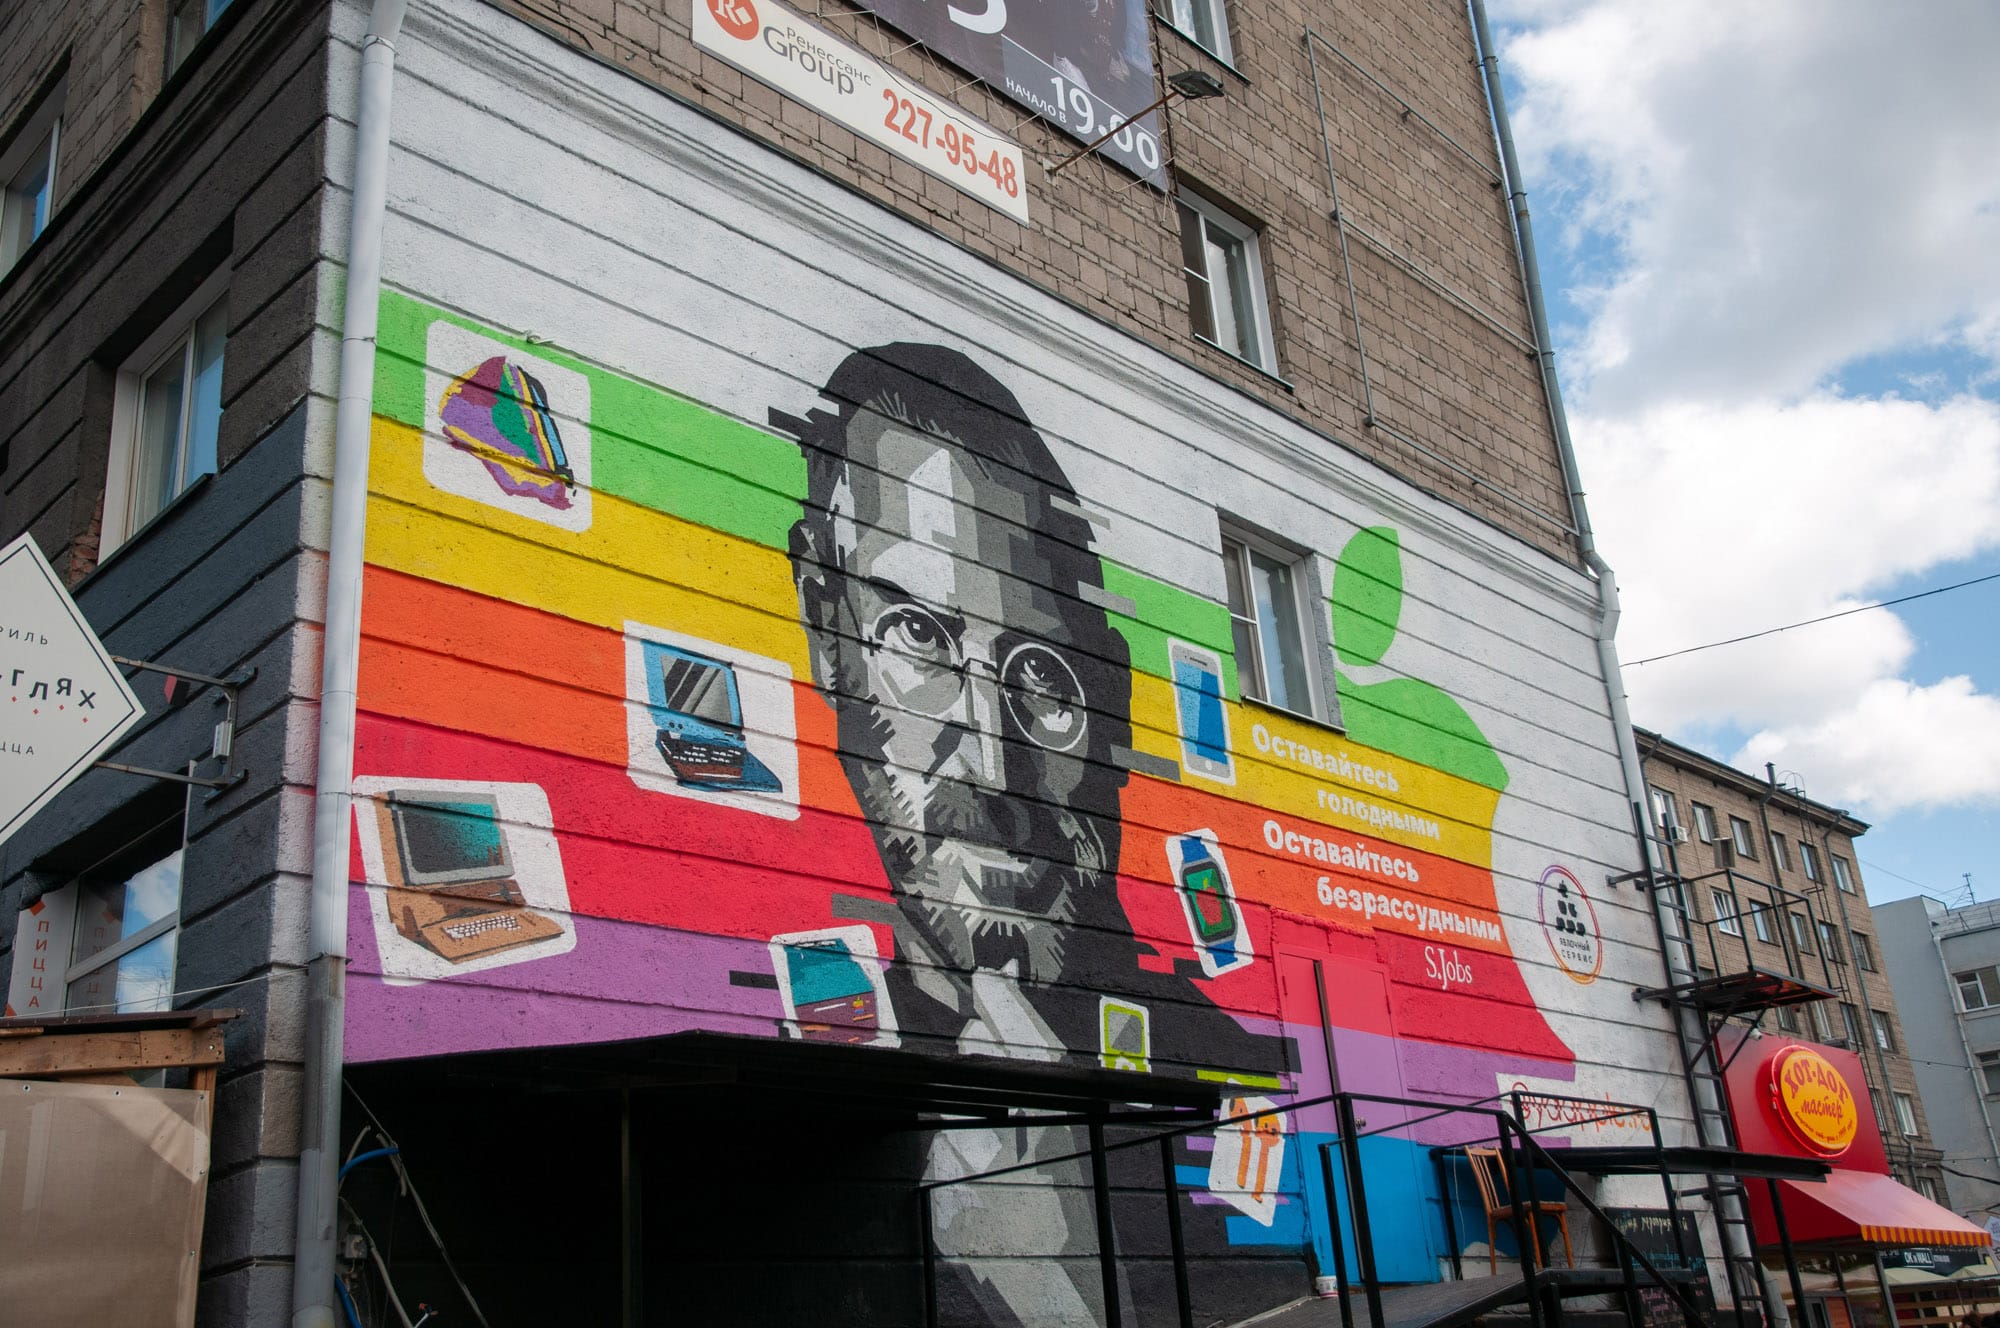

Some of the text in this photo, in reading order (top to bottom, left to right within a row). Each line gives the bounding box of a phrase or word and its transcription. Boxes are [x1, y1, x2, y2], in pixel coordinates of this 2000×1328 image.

[763, 25, 855, 95] Group
[785, 26, 872, 86] Ренессанс
[882, 88, 1018, 199] 227-95-48
[1005, 77, 1056, 118] НАЧАЛО
[1049, 75, 1160, 171] 19.00
[0, 626, 48, 645] ИЛЬ
[0, 668, 97, 710] ГЛЯХ
[1252, 724, 1400, 793] Оставайтесь
[1317, 788, 1441, 840] голодными
[1263, 820, 1420, 883] Оставайтесь
[1316, 876, 1501, 942] безрассудными
[29, 920, 50, 1008] ПИЦЦА
[1424, 945, 1473, 990] S.Jobs
[1561, 949, 1593, 964] СЕРВИС
